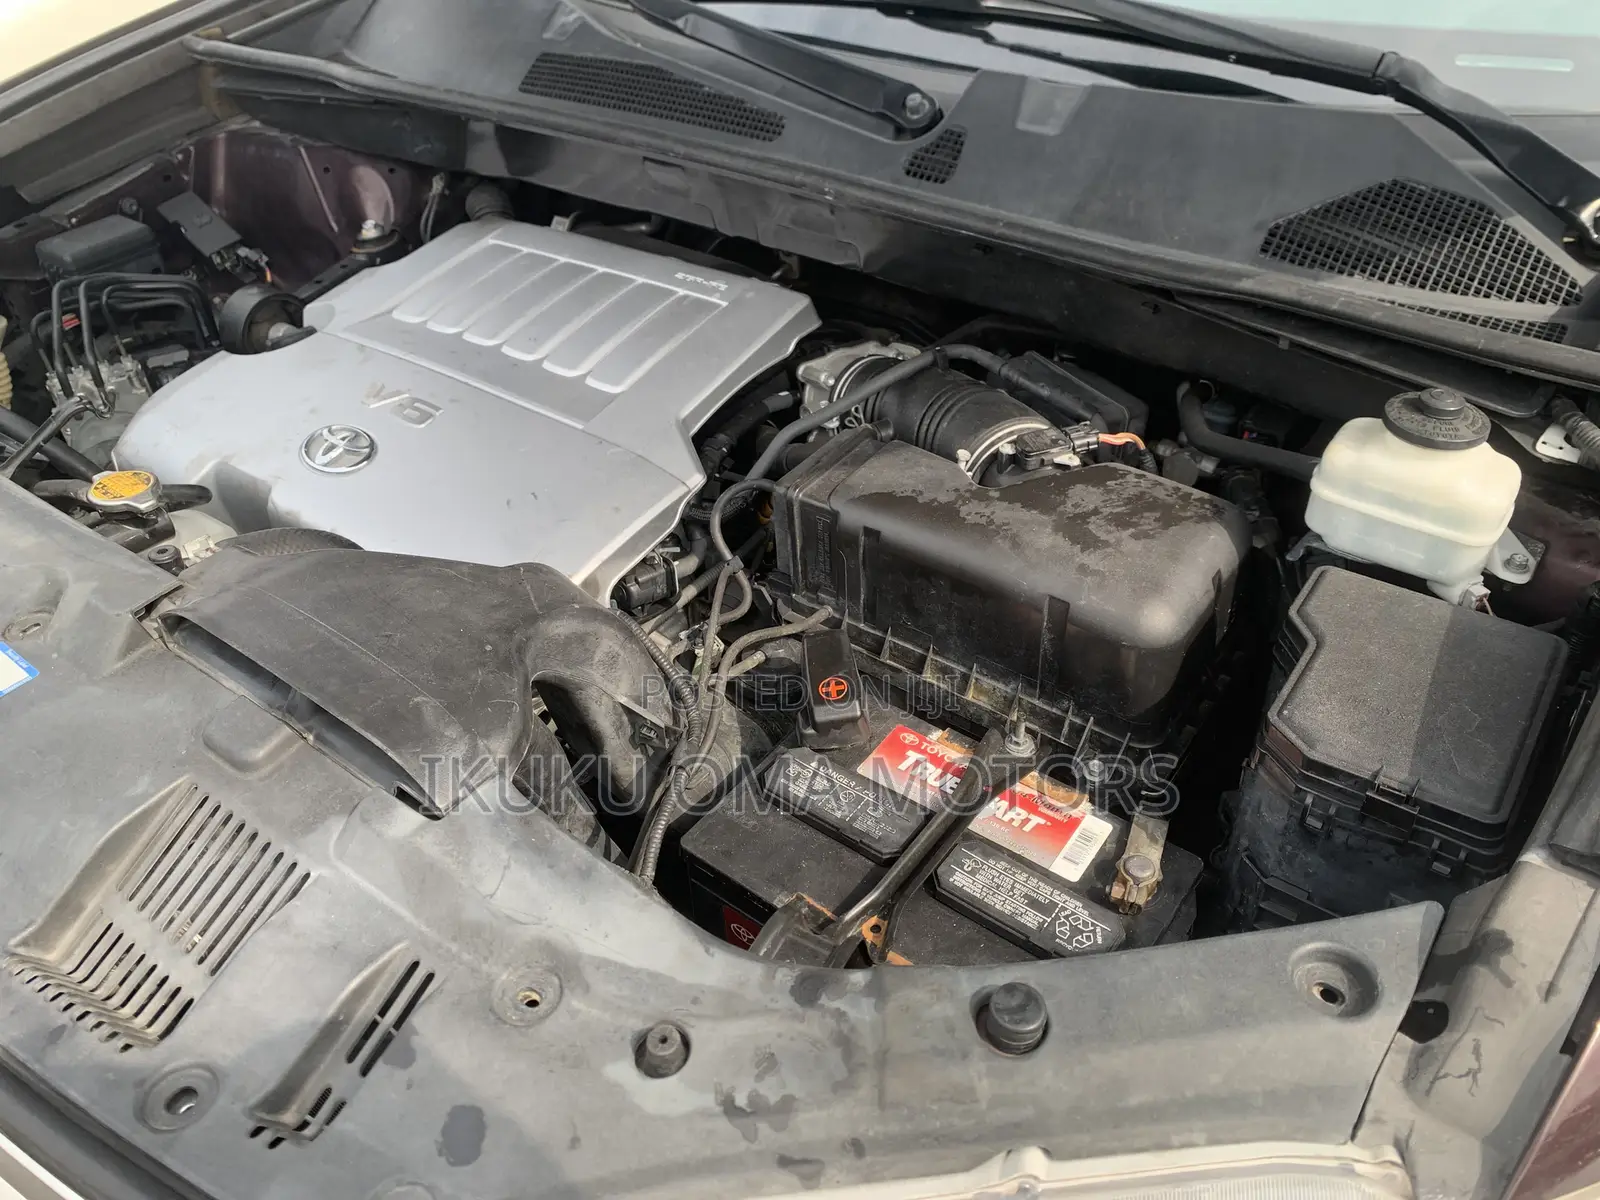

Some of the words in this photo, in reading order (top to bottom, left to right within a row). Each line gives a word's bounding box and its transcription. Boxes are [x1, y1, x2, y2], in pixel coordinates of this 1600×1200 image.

[361, 381, 444, 428] V6
[921, 741, 968, 770] TOYOA
[819, 765, 854, 789] DANGER
[897, 750, 961, 795] TRUE
[974, 873, 998, 888] MEDICAL
[998, 886, 1013, 897] HELP
[1013, 893, 1028, 905] FAST
[978, 868, 992, 879] WITH
[1012, 887, 1025, 897] GET
[981, 864, 999, 877] FLUSH
[999, 873, 1013, 884] EYES
[1013, 881, 1050, 904] IMMEDIATELY
